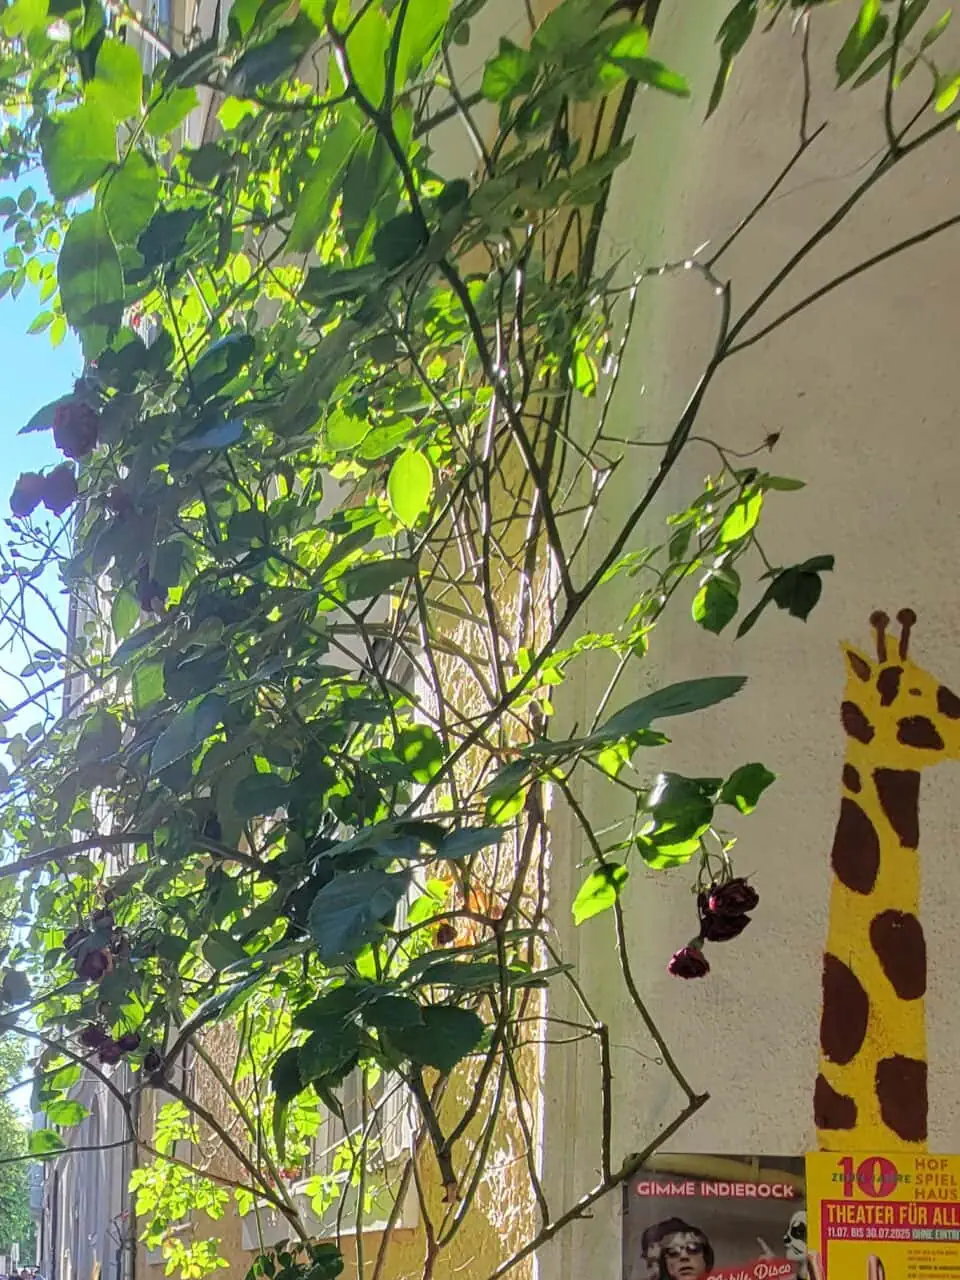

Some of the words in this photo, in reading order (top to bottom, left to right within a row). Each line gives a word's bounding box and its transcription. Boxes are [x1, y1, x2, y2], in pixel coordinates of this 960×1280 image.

[915, 1158, 949, 1170] HOF
[915, 1173, 957, 1186] SPIEL
[637, 1182, 695, 1196] GIMME
[700, 1184, 794, 1198] INDIEROCK
[914, 1188, 958, 1200] HAUS
[827, 1204, 894, 1225] THEATER
[899, 1202, 928, 1225] FÜR
[754, 1263, 791, 1280] Disco
